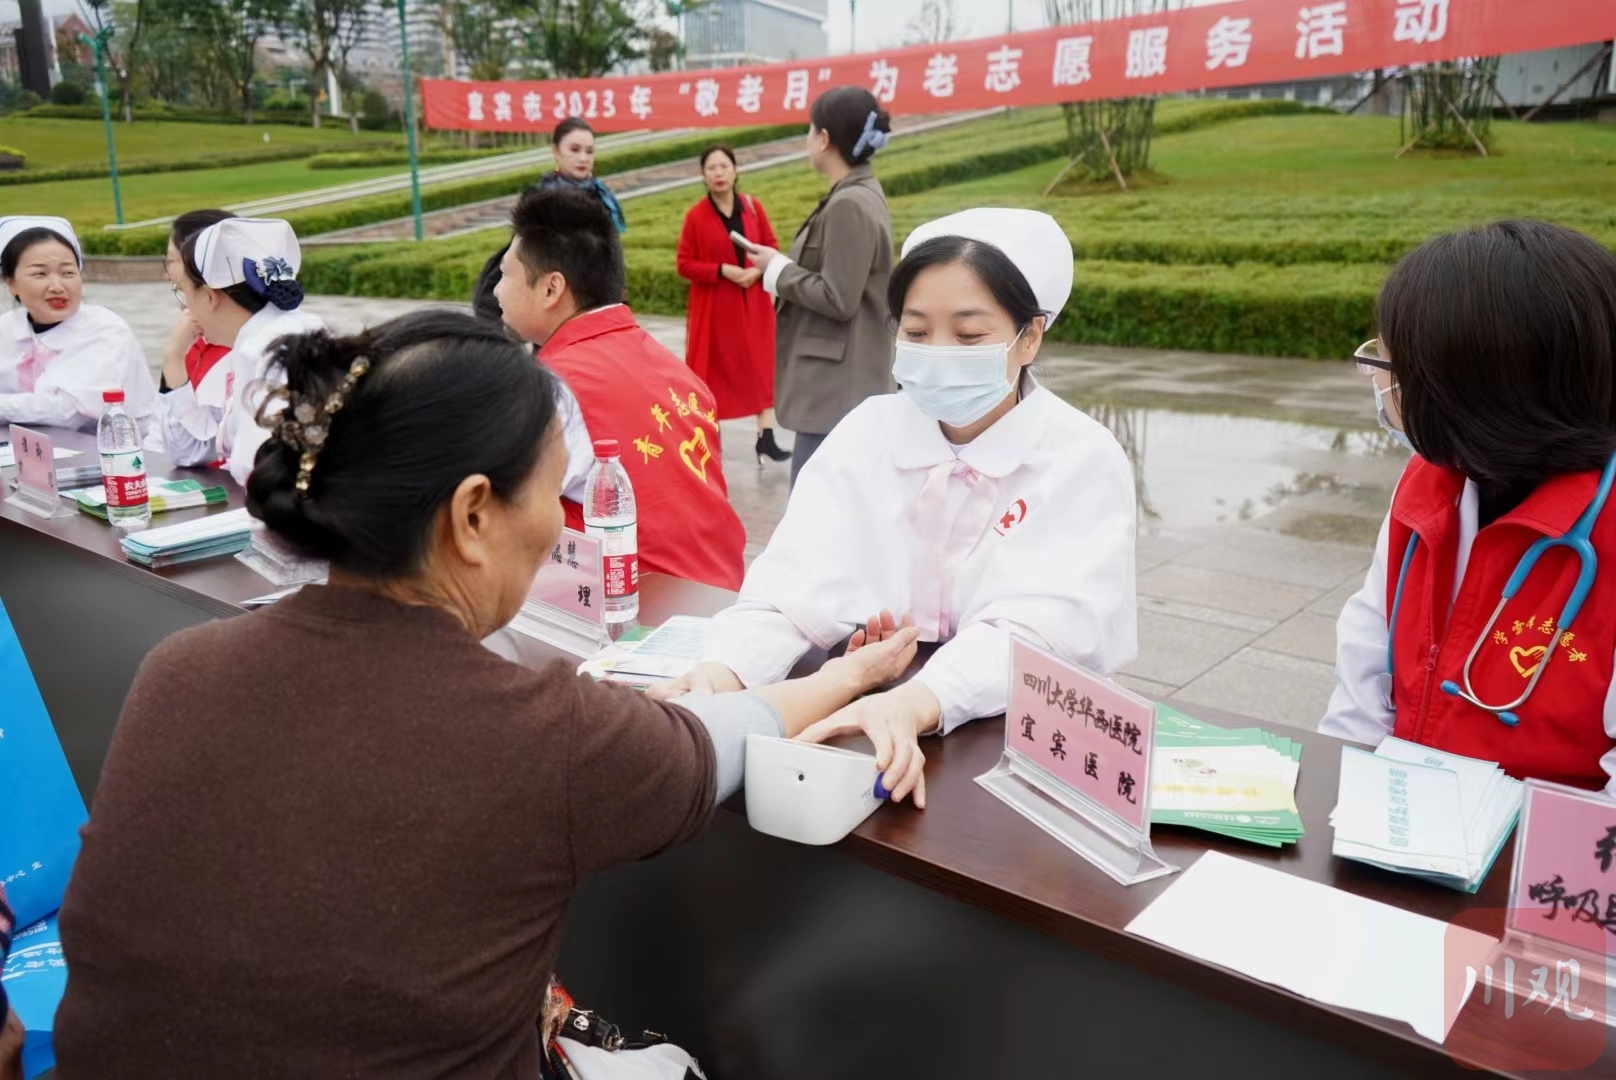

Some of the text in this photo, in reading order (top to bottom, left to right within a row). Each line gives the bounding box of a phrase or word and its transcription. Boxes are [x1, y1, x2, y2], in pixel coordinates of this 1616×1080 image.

[1023, 672, 1143, 755] 四川大学华西医院
[1021, 713, 1136, 805] 宜宾医院
